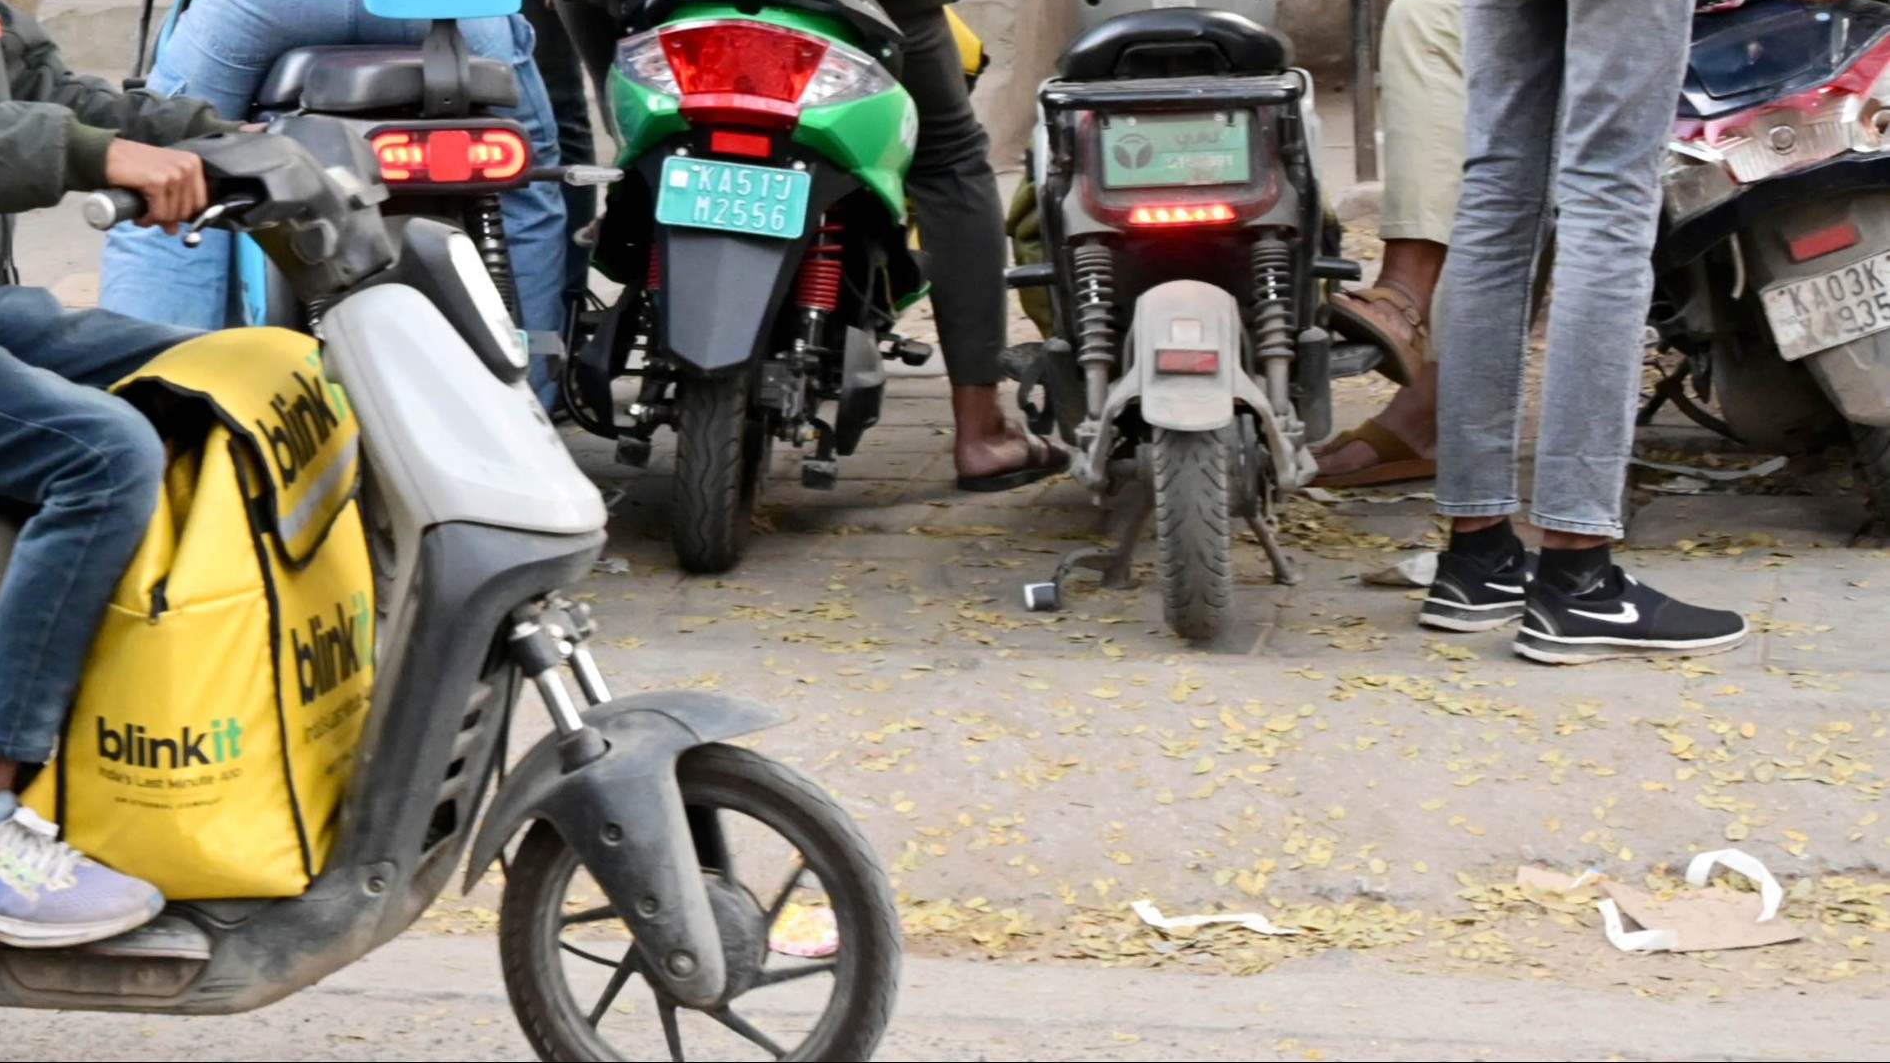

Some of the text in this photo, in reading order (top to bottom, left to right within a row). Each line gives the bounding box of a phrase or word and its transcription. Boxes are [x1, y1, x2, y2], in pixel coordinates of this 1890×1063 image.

[698, 166, 792, 201] KA51J
[693, 195, 787, 231] M2556
[1788, 259, 1885, 317] KA03K
[96, 715, 243, 769] blinkit
